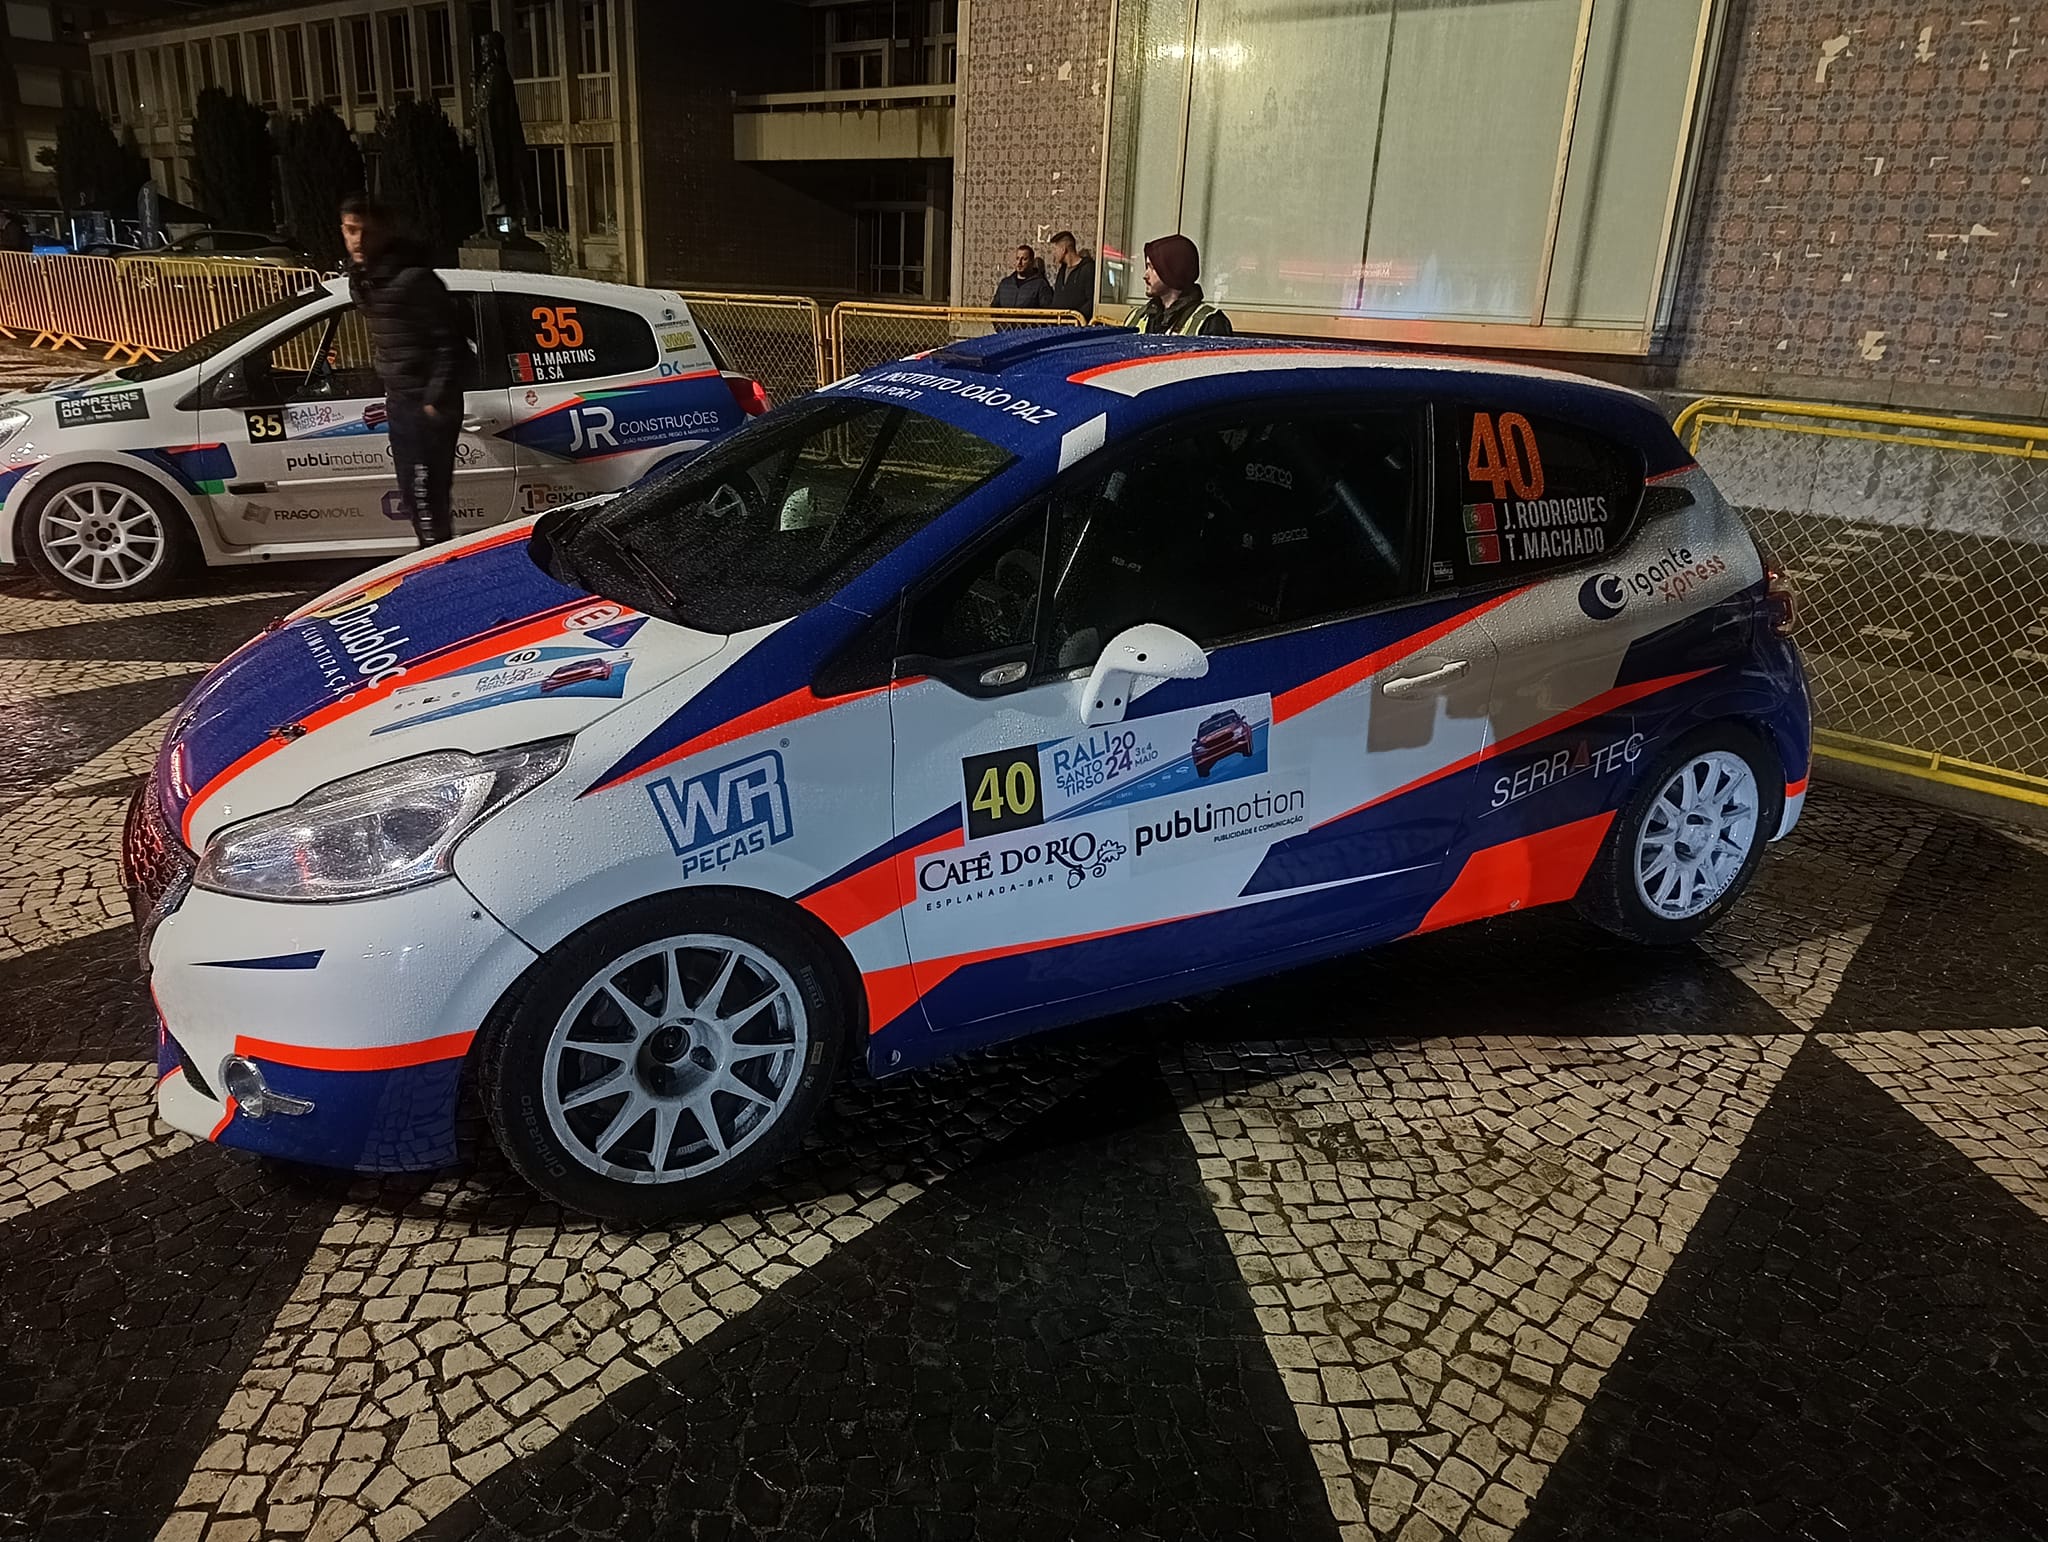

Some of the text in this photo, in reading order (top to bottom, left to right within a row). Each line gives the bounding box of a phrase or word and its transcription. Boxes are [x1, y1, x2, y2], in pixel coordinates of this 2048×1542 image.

[532, 307, 584, 348] 35
[661, 331, 695, 348] VMC
[533, 349, 596, 366] H.MARTINS
[61, 391, 139, 409] ARMAZENS
[62, 401, 132, 418] DO LIMA
[289, 405, 319, 421] RALI
[880, 371, 1058, 425] INSTITUTO JOÃO PAZ
[249, 413, 282, 438] 35
[568, 406, 719, 452] JR CONSTRUÇÕES
[286, 452, 384, 472] publimotion
[1467, 411, 1545, 500] 40
[274, 507, 365, 521] FRAGOMOVEL
[1503, 496, 1608, 529] J.RODRIGUES
[1505, 527, 1605, 562] T.MACHADO
[508, 651, 537, 663] 40
[1053, 730, 1136, 776] RALI 20
[1056, 749, 1134, 789] SANTO 24
[1134, 750, 1159, 767] MAIO
[971, 761, 1037, 821] 40
[1063, 772, 1104, 798] TIRSO
[645, 749, 794, 857] WR
[1135, 789, 1304, 857] publimotion
[1213, 828, 1252, 843] PUBLICIDADE
[1258, 815, 1303, 832] COMUNICAÇÃO
[681, 830, 766, 880] PEÇAS
[919, 832, 1097, 892] CAFÉ DO RIO
[926, 874, 1054, 912] ESPLANADA-BAR
